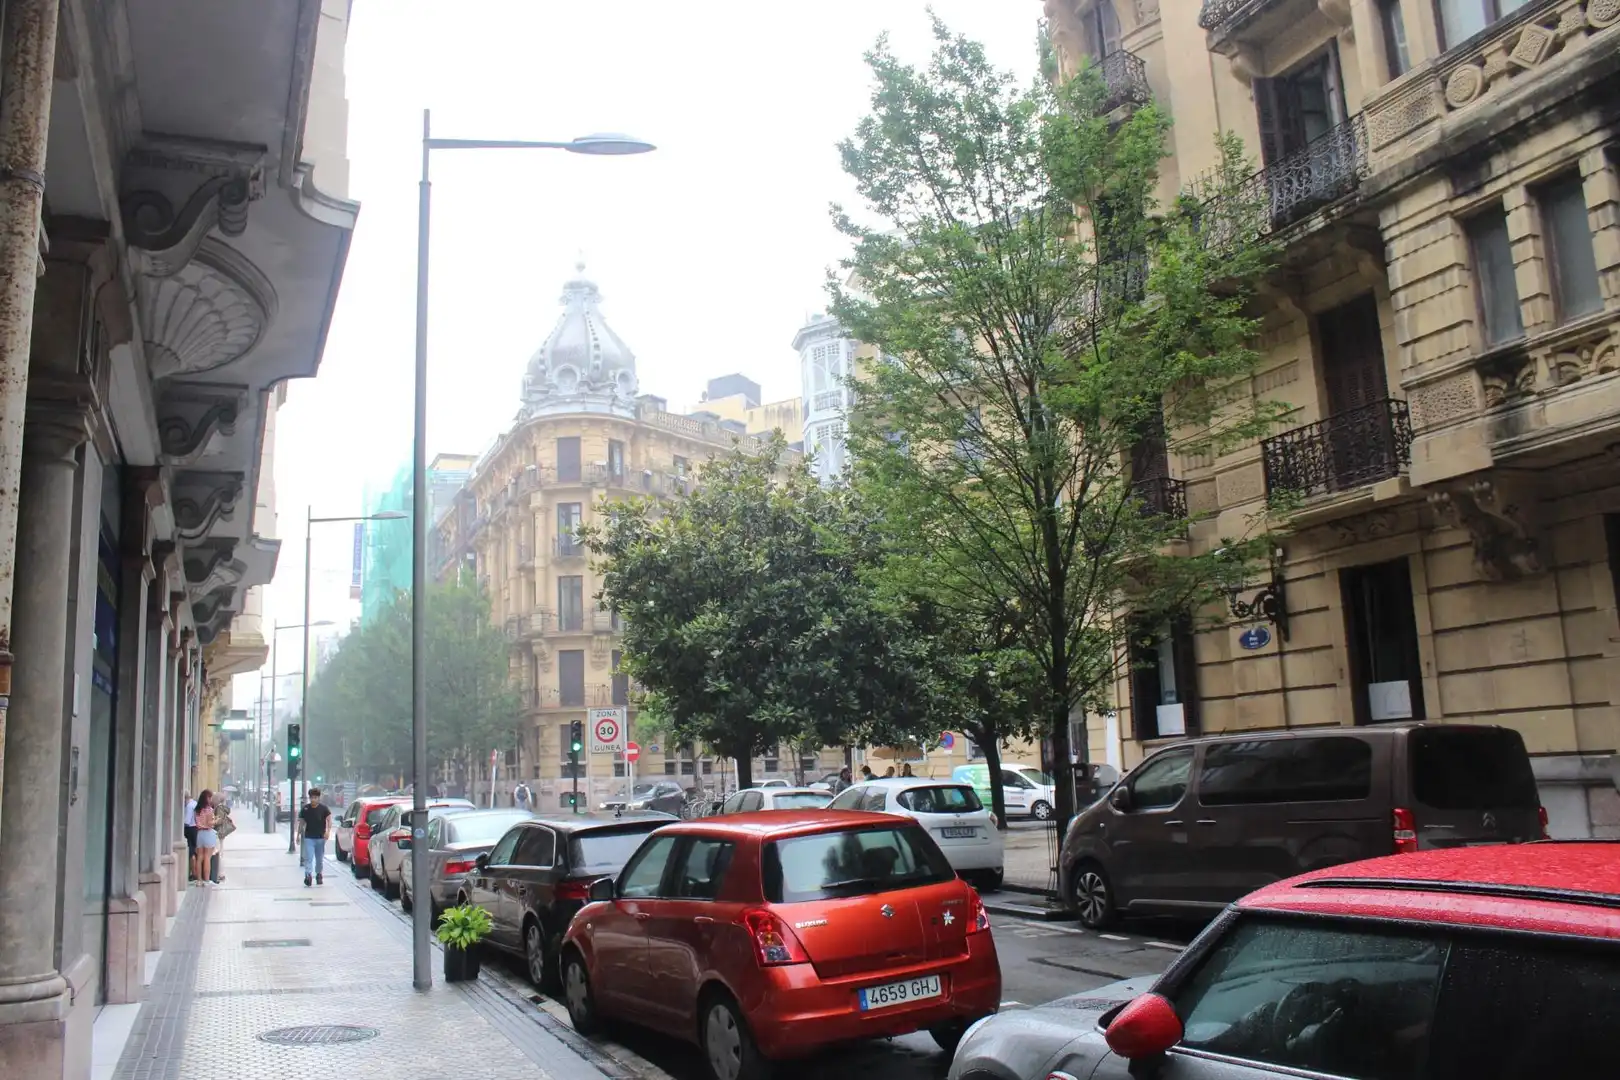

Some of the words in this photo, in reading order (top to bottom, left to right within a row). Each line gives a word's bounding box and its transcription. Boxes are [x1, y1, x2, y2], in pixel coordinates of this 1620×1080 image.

[600, 726, 614, 735] 30
[870, 984, 907, 1005] 4659
[911, 977, 939, 996] GHJ
